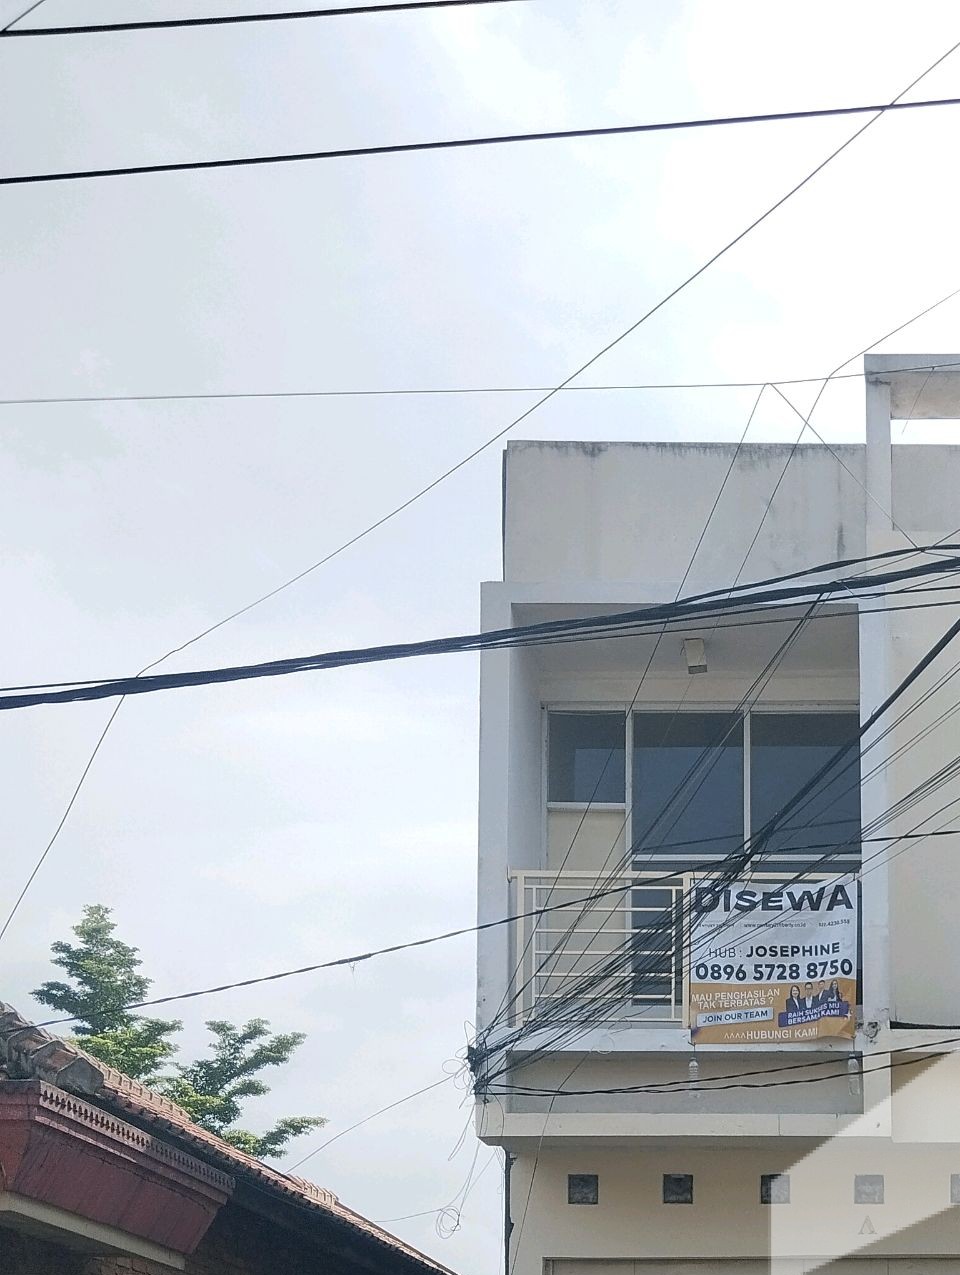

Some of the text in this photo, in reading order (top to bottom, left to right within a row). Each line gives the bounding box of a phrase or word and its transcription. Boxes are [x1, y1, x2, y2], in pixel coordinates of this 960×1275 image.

[694, 884, 854, 912] DISEWA
[746, 942, 840, 958] JOSEPHINE
[695, 958, 853, 981] 0896 5728 8750
[691, 988, 780, 1002] MAU PENGHASILAN
[698, 1001, 716, 1010] TAK
[718, 998, 766, 1009] TERBATAS
[788, 1002, 840, 1019] RAIH SUKSES MU
[703, 1010, 768, 1023] JOIN OUR TEAM
[787, 1009, 840, 1025] BERSAMA KAMI
[795, 1027, 818, 1038] KAMI
